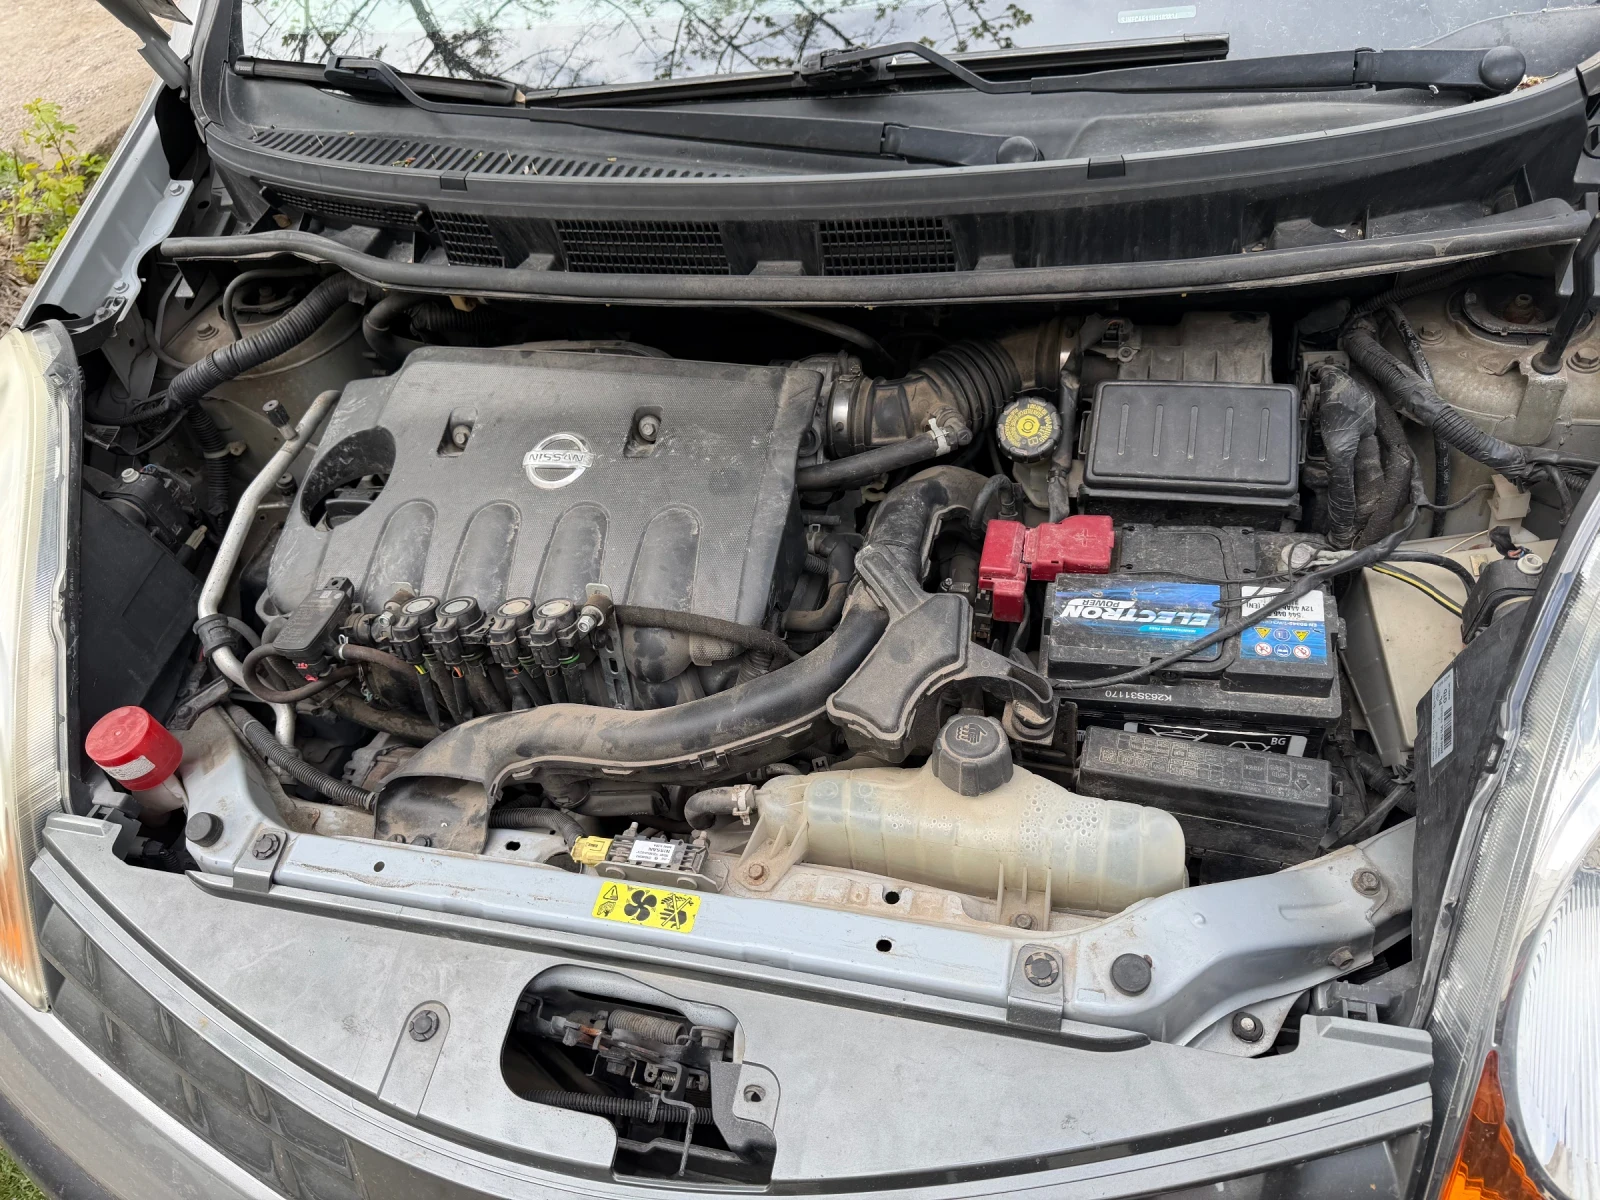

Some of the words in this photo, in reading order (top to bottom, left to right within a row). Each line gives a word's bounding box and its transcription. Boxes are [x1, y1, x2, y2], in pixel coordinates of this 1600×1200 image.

[528, 453, 584, 462] NISSAN
[1081, 598, 1121, 608] POWER
[1060, 604, 1213, 628] ELECTRON
[1104, 690, 1173, 702] K263S31170
[1270, 736, 1287, 746] BG
